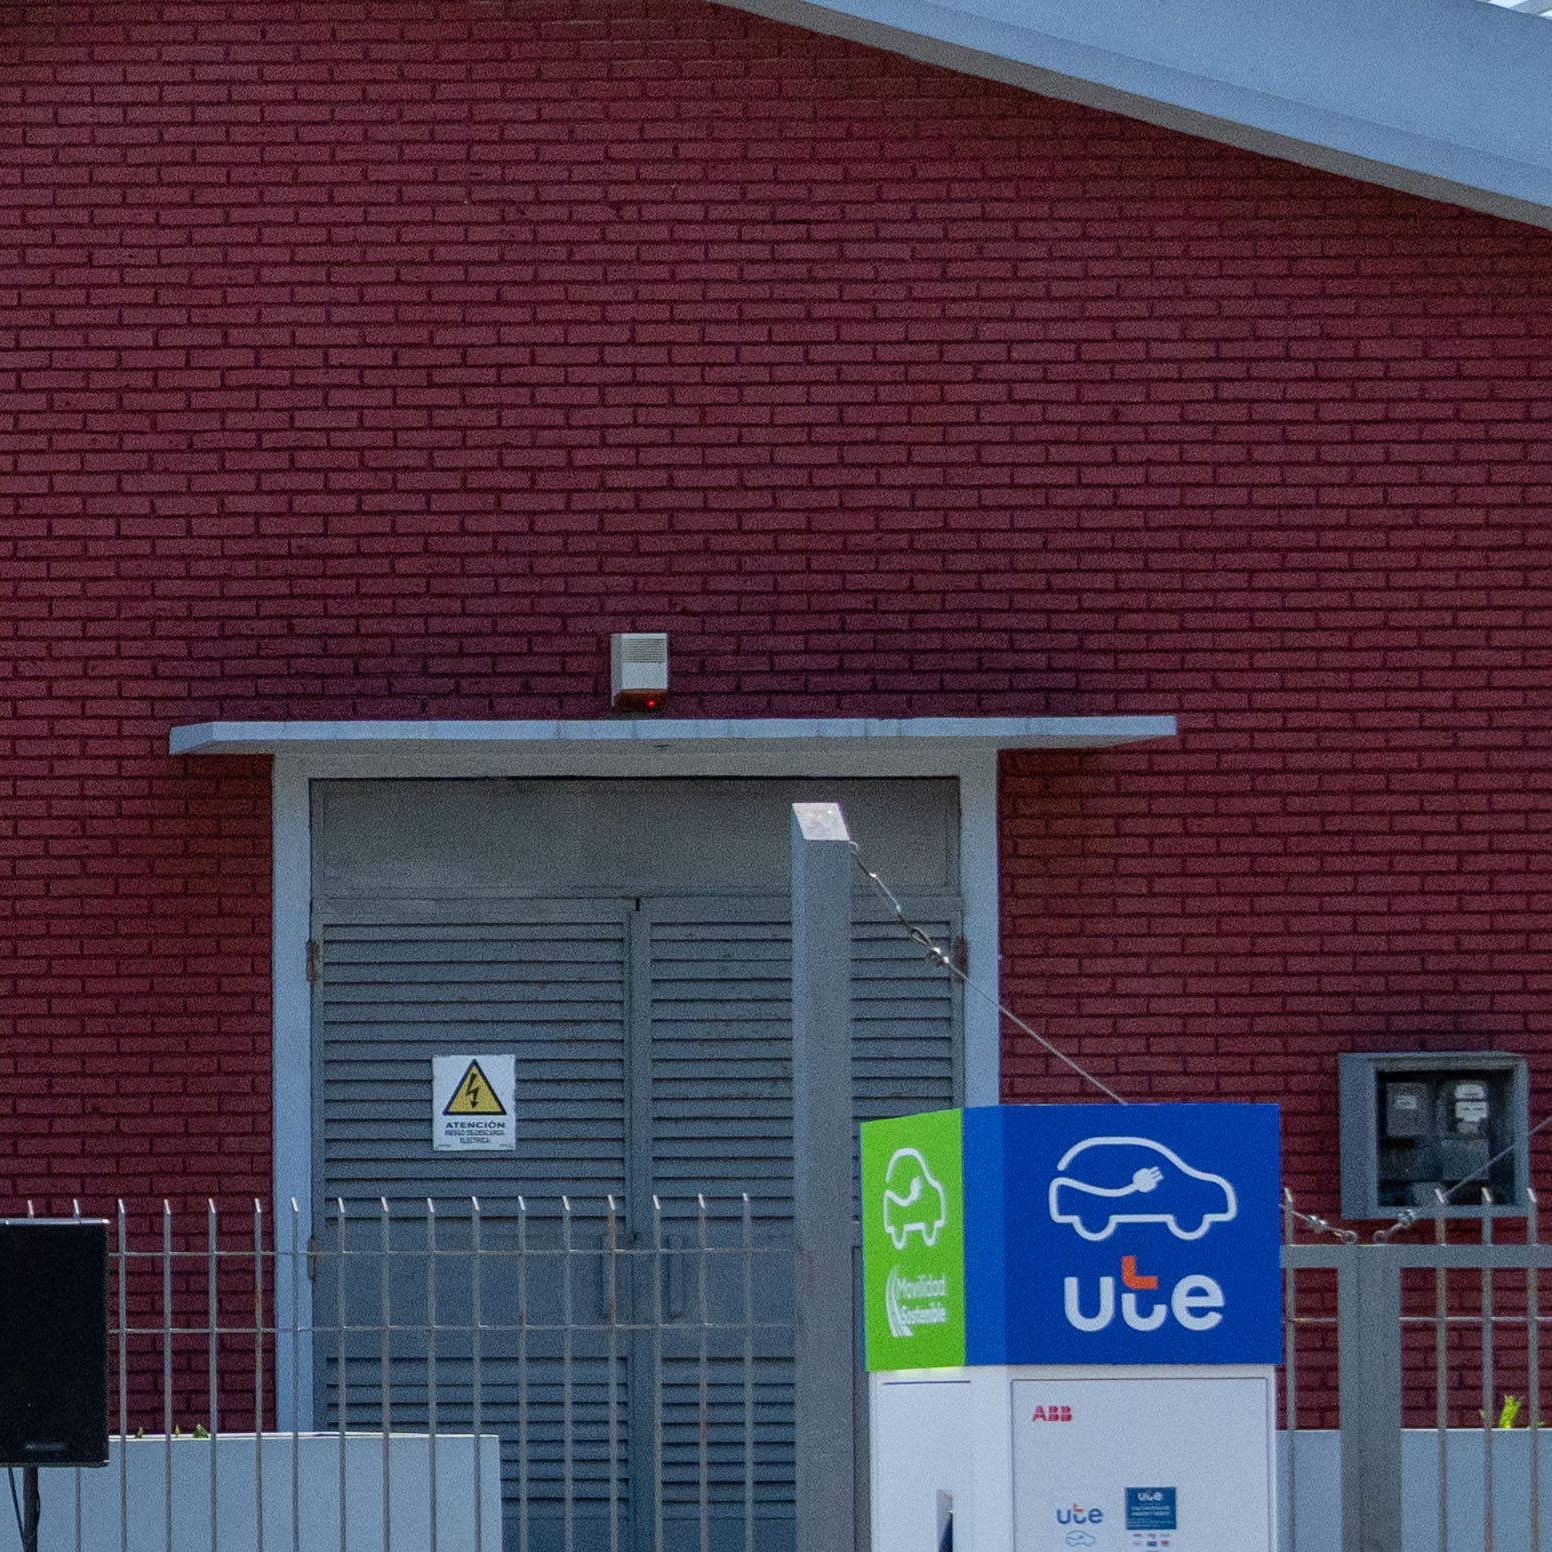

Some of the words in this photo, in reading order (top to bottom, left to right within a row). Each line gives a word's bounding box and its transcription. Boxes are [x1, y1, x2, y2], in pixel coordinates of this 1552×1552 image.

[446, 1120, 505, 1128] ATENCIÓN
[1064, 1256, 1226, 1333] ute
[1032, 1405, 1073, 1423] ABB
